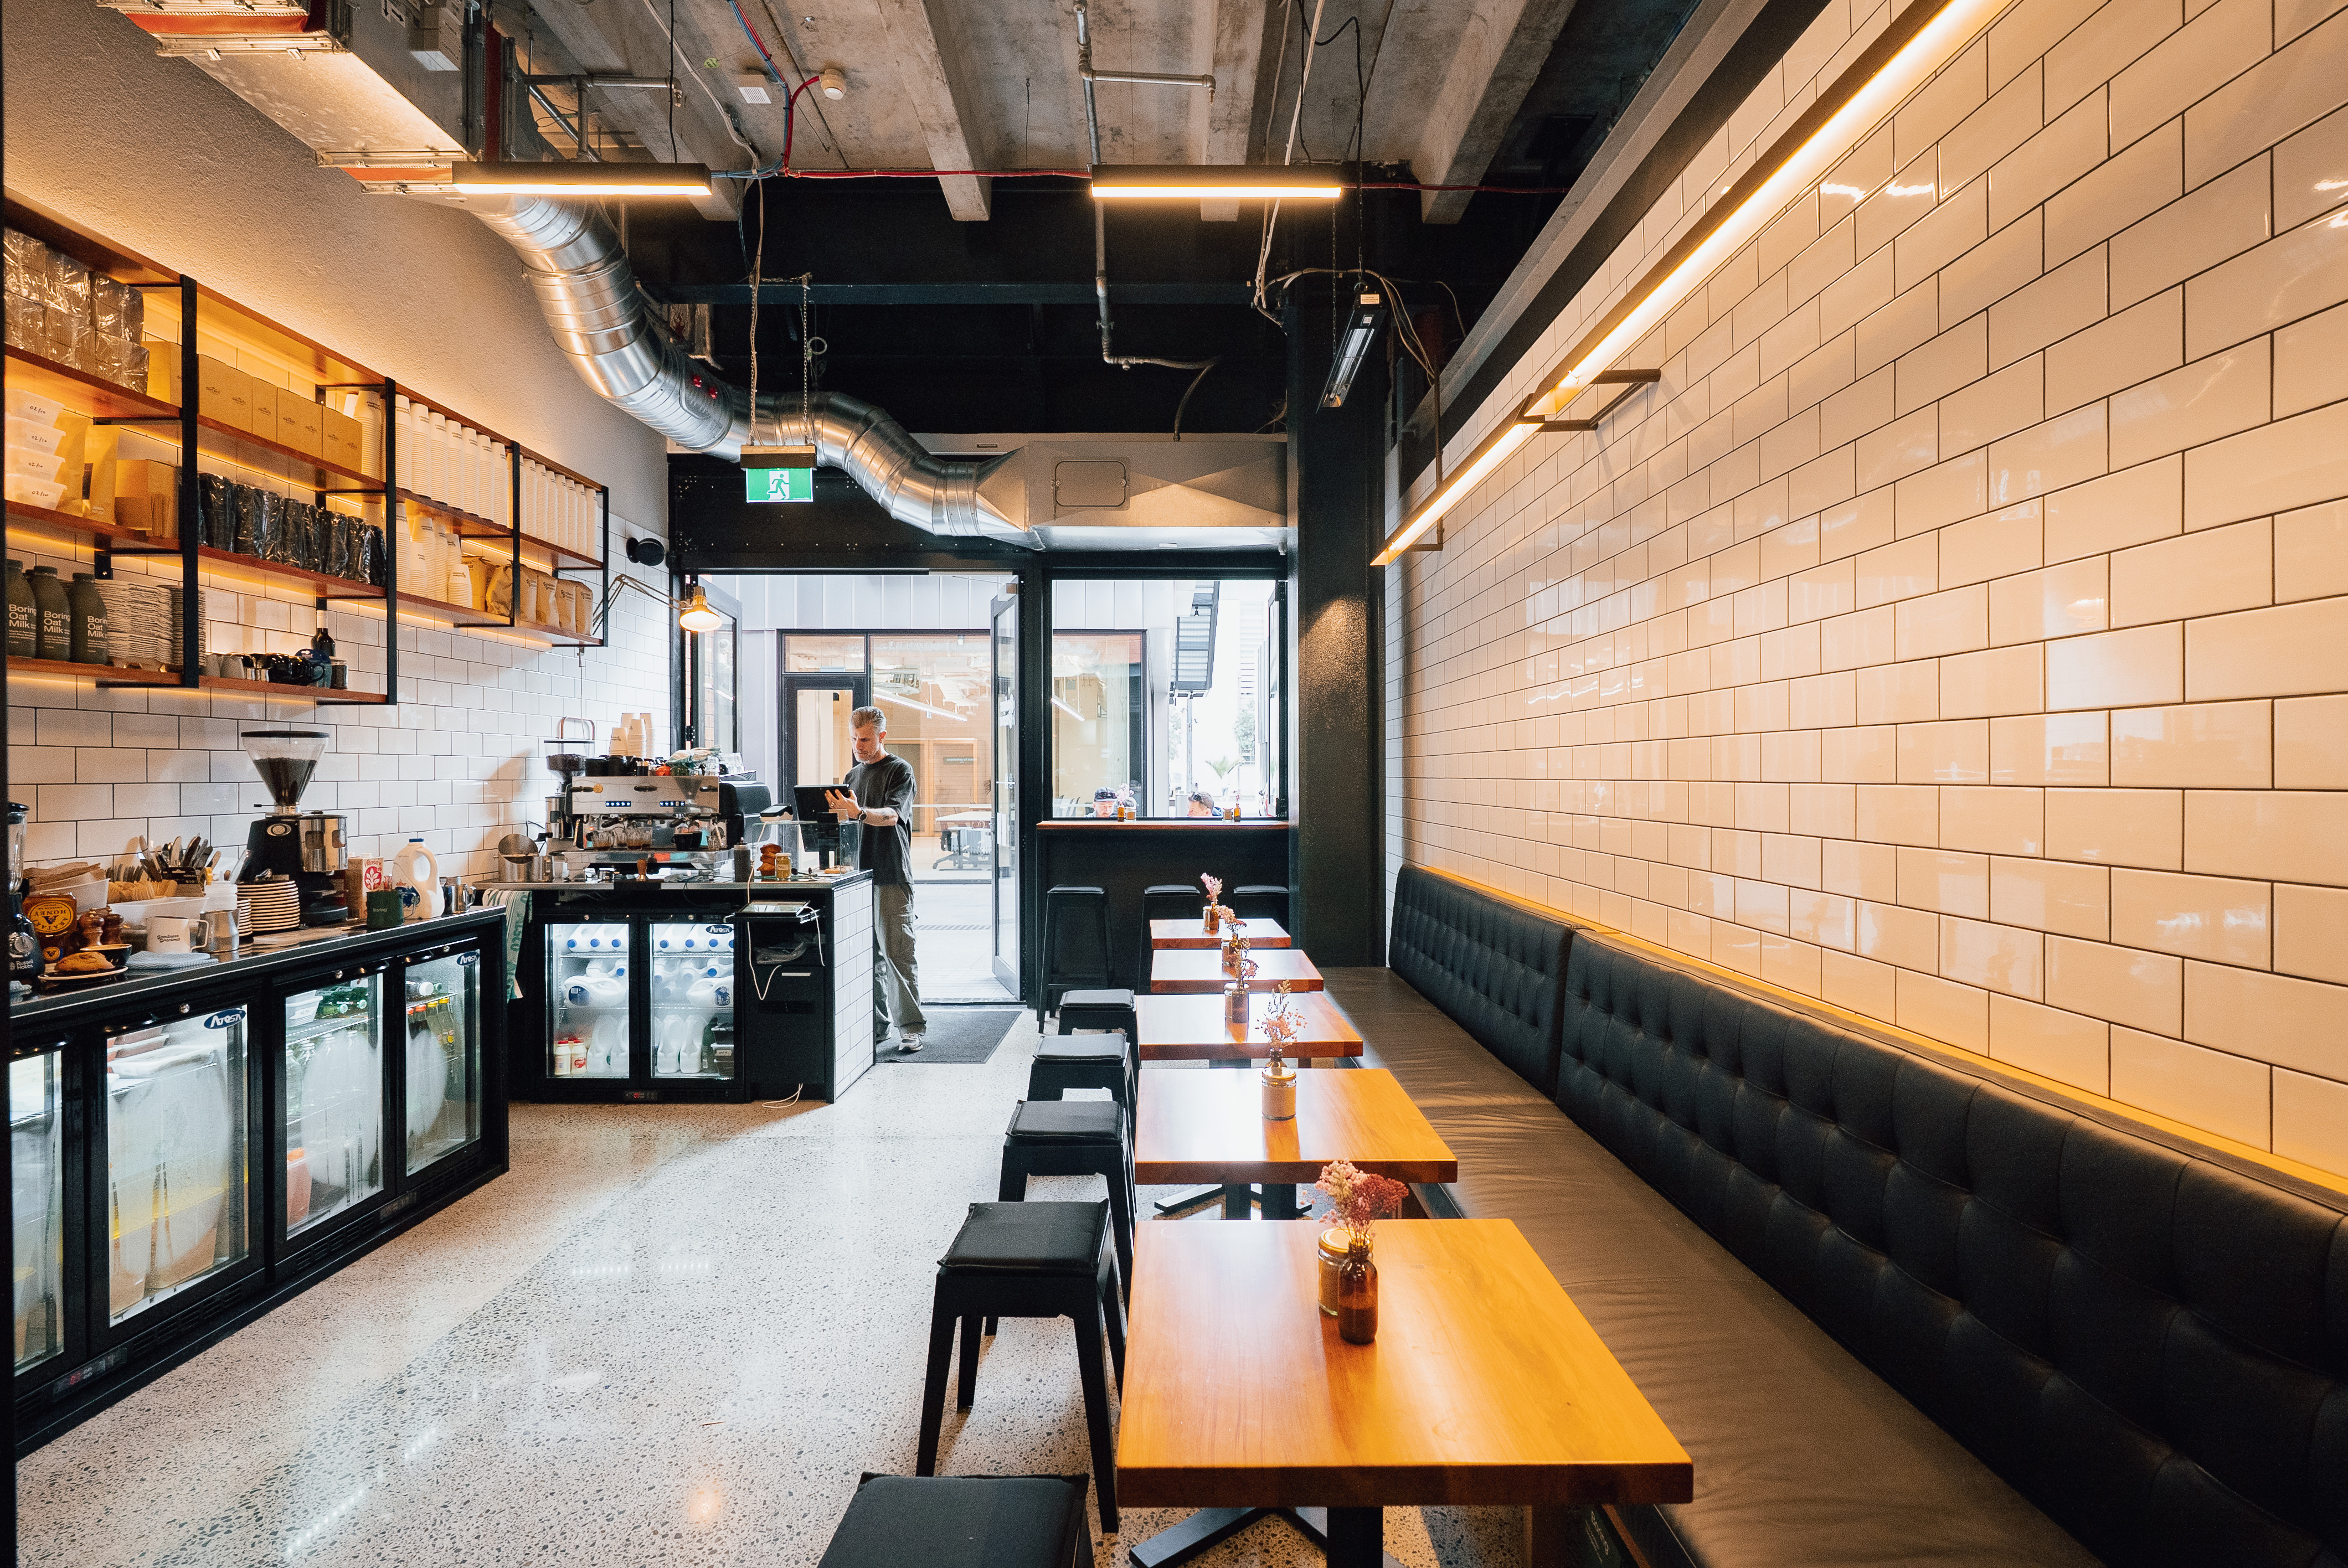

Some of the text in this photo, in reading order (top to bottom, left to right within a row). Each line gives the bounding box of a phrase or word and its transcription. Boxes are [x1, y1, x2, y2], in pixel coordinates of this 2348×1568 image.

[29, 406, 46, 414] 02/10
[9, 604, 37, 616] Boring
[9, 612, 28, 621] Oat
[44, 611, 71, 622] Boring
[87, 616, 107, 625] Borin
[9, 620, 30, 628] Milk
[43, 618, 61, 626] Oat
[44, 625, 64, 634] Milk
[87, 623, 103, 631] Oat
